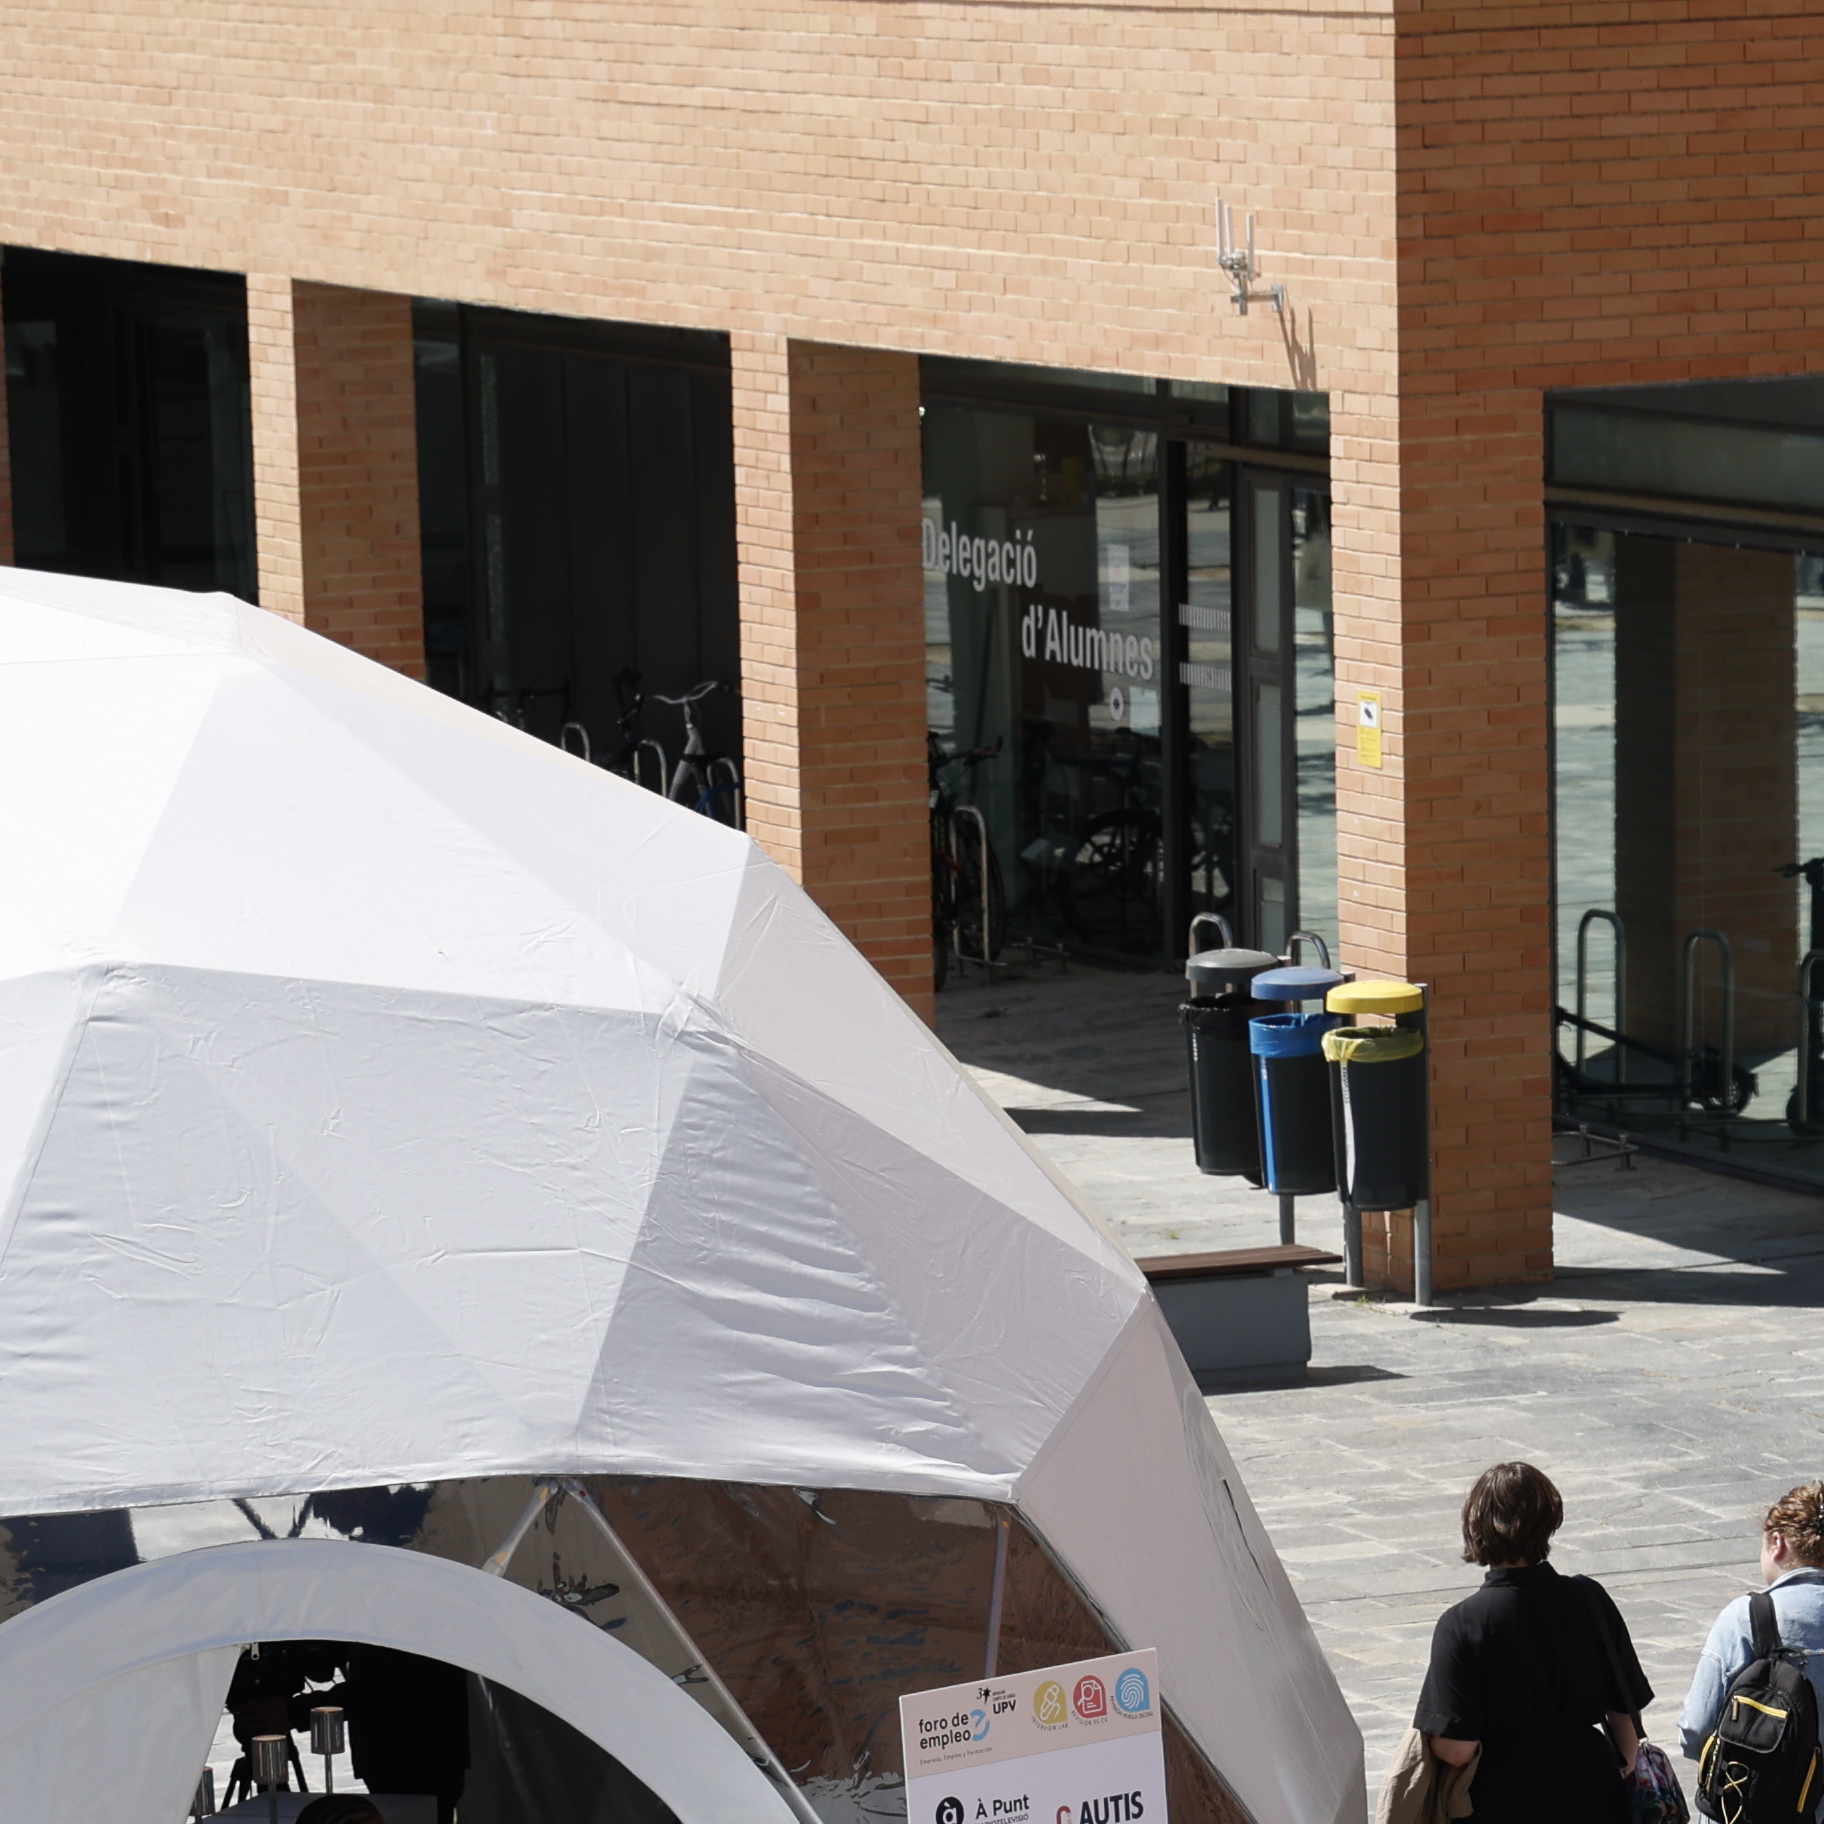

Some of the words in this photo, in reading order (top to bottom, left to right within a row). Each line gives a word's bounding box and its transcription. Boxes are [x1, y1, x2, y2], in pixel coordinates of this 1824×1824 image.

[921, 518, 1037, 592] Delegació
[992, 1699, 1016, 1715] UPV
[918, 1718, 948, 1734] foro
[951, 1712, 969, 1727] de
[919, 1729, 971, 1750] empleo
[975, 1798, 988, 1820] À
[993, 1794, 1030, 1816] Punt
